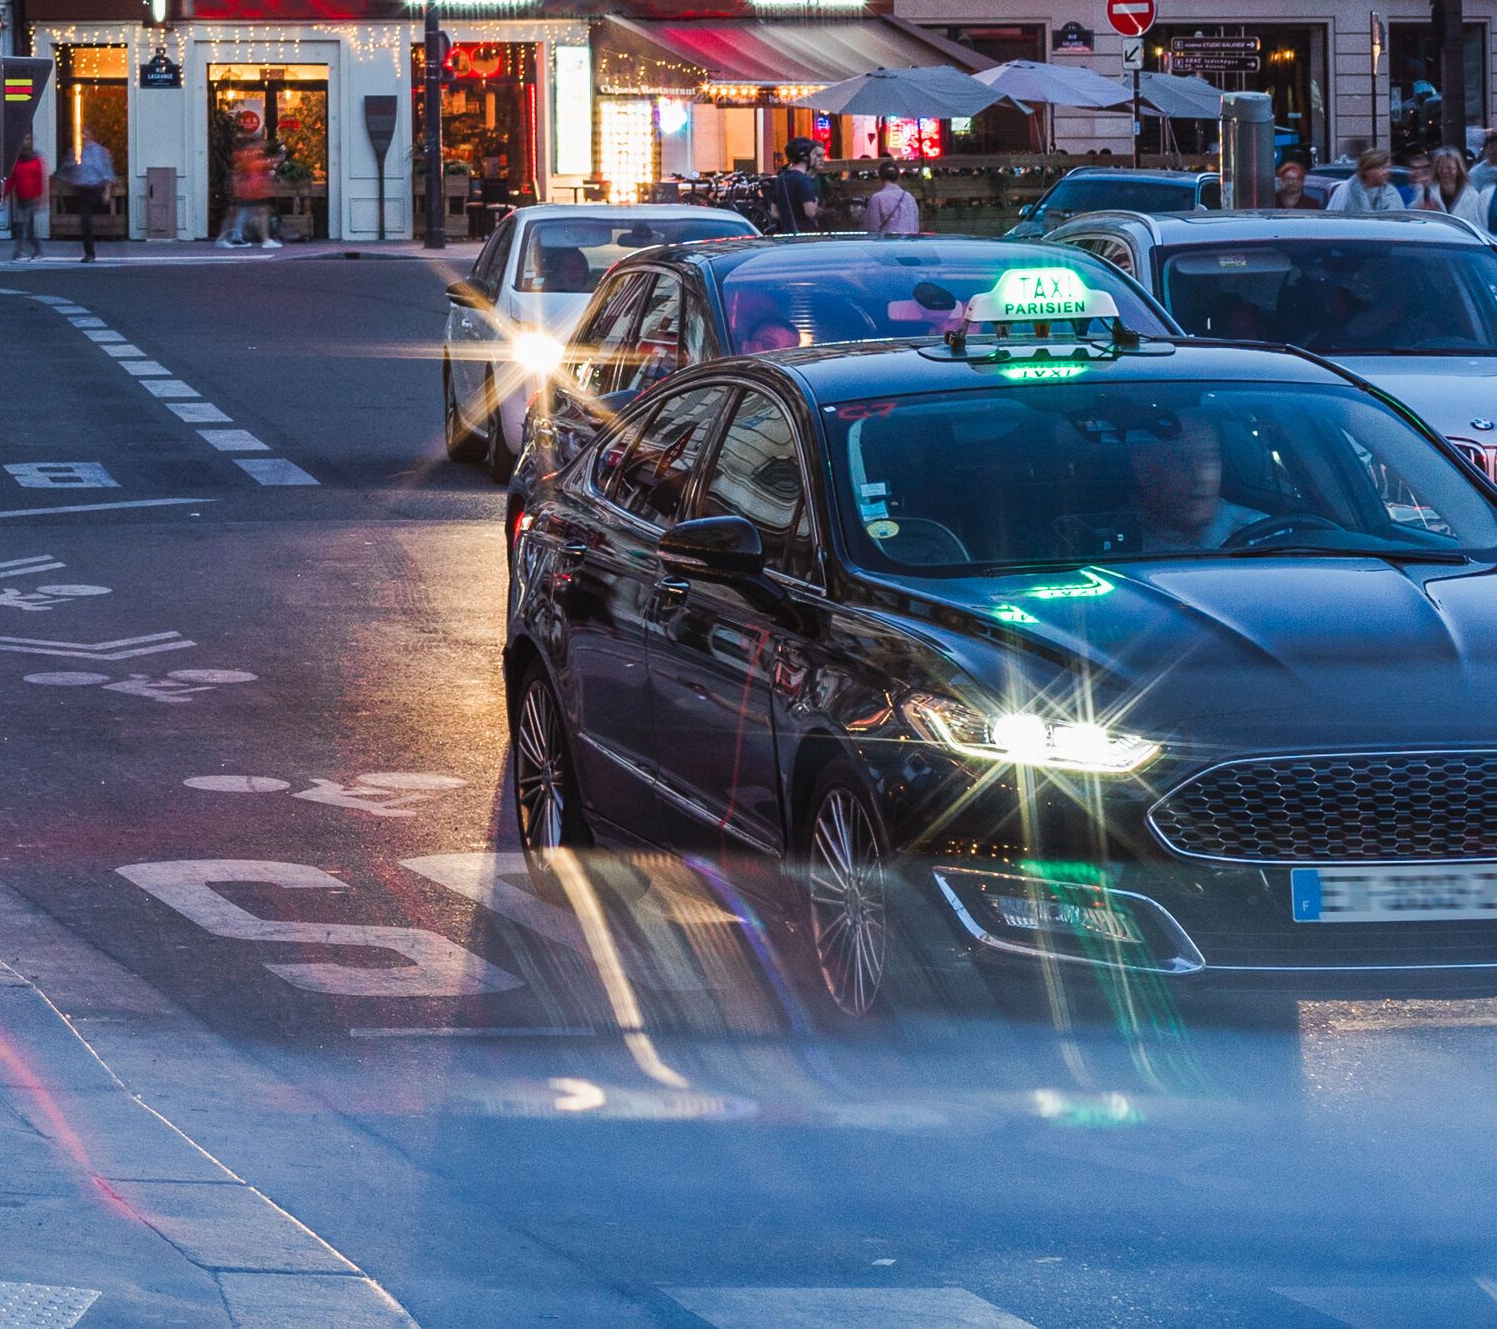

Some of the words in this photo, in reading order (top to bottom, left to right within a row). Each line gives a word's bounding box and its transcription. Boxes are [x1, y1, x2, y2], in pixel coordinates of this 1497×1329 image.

[1018, 275, 1072, 300] TAXI
[1005, 301, 1085, 315] PARISIEN
[1302, 900, 1310, 912] F
